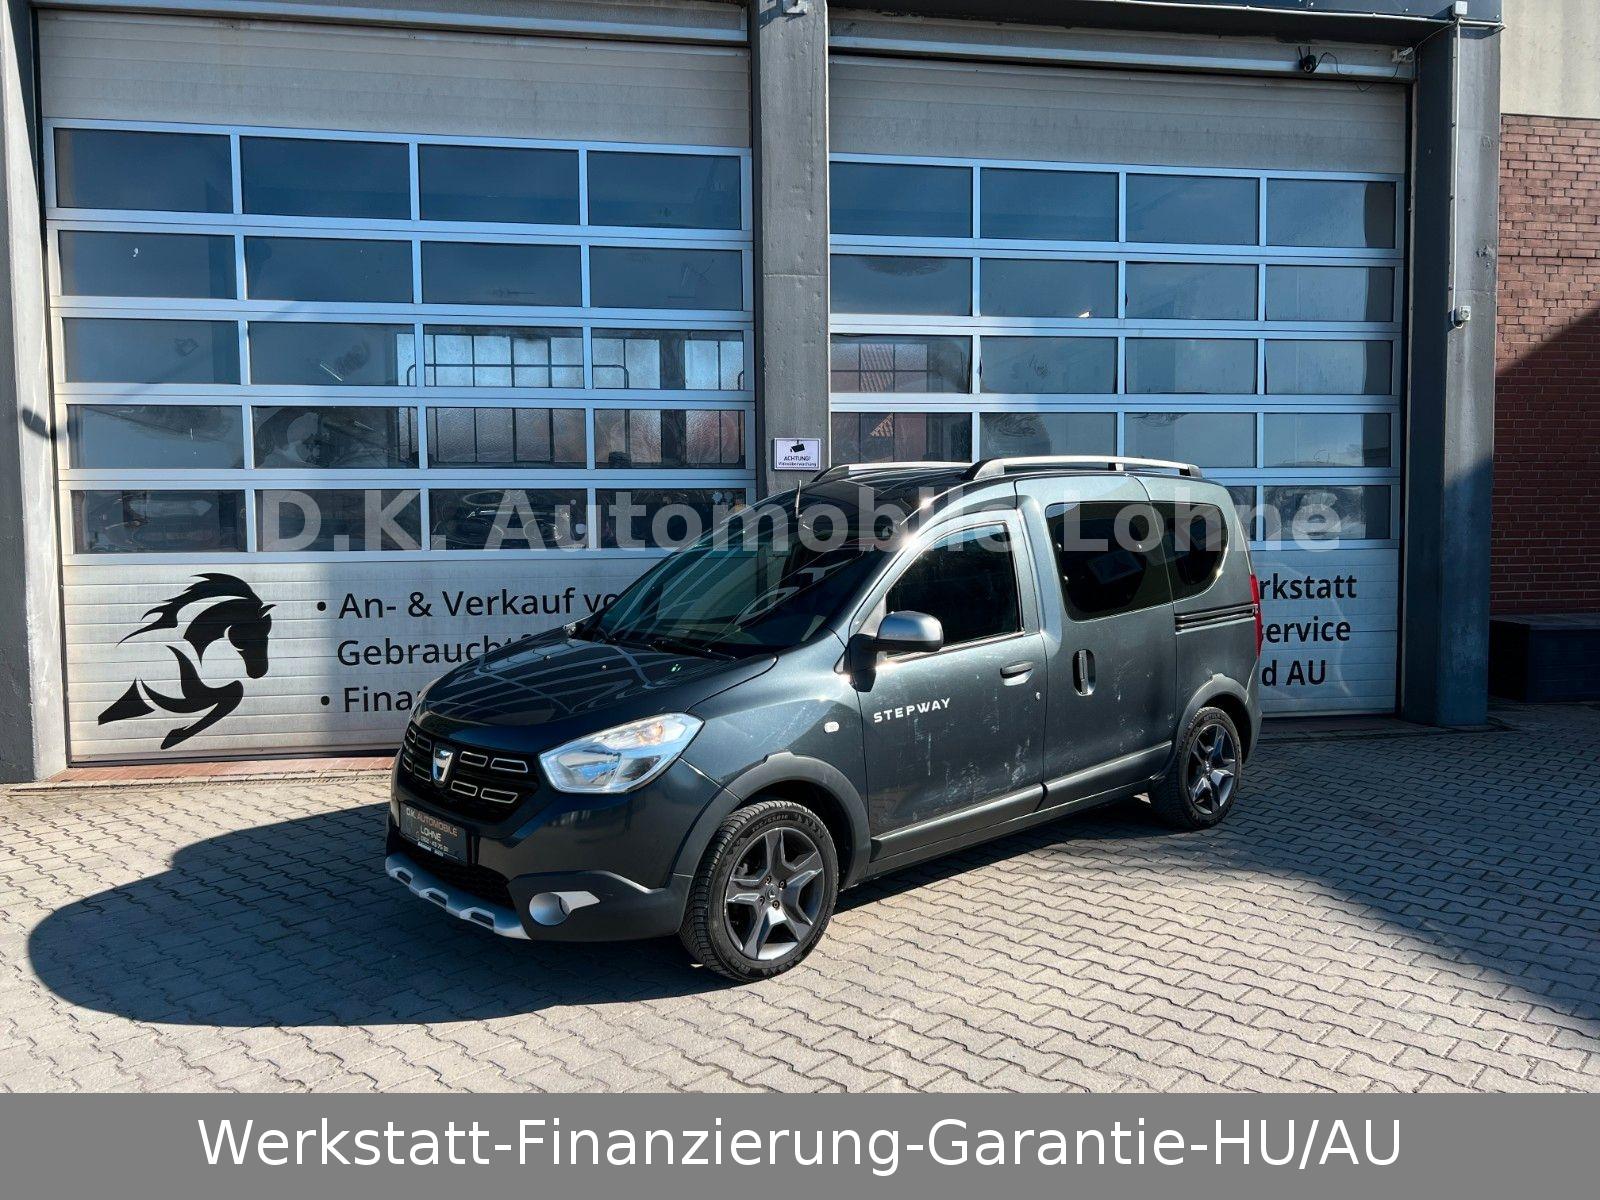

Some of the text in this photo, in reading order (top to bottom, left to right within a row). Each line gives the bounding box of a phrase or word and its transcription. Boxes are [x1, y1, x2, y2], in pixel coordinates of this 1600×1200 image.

[338, 592, 396, 619] An-
[407, 591, 432, 618] &
[442, 586, 576, 617] Verkauf
[1262, 616, 1350, 643] ervice
[1286, 660, 1326, 686] AU
[343, 685, 421, 713] Fina
[873, 697, 951, 723] STEPWAY
[420, 825, 442, 842] LOHNE
